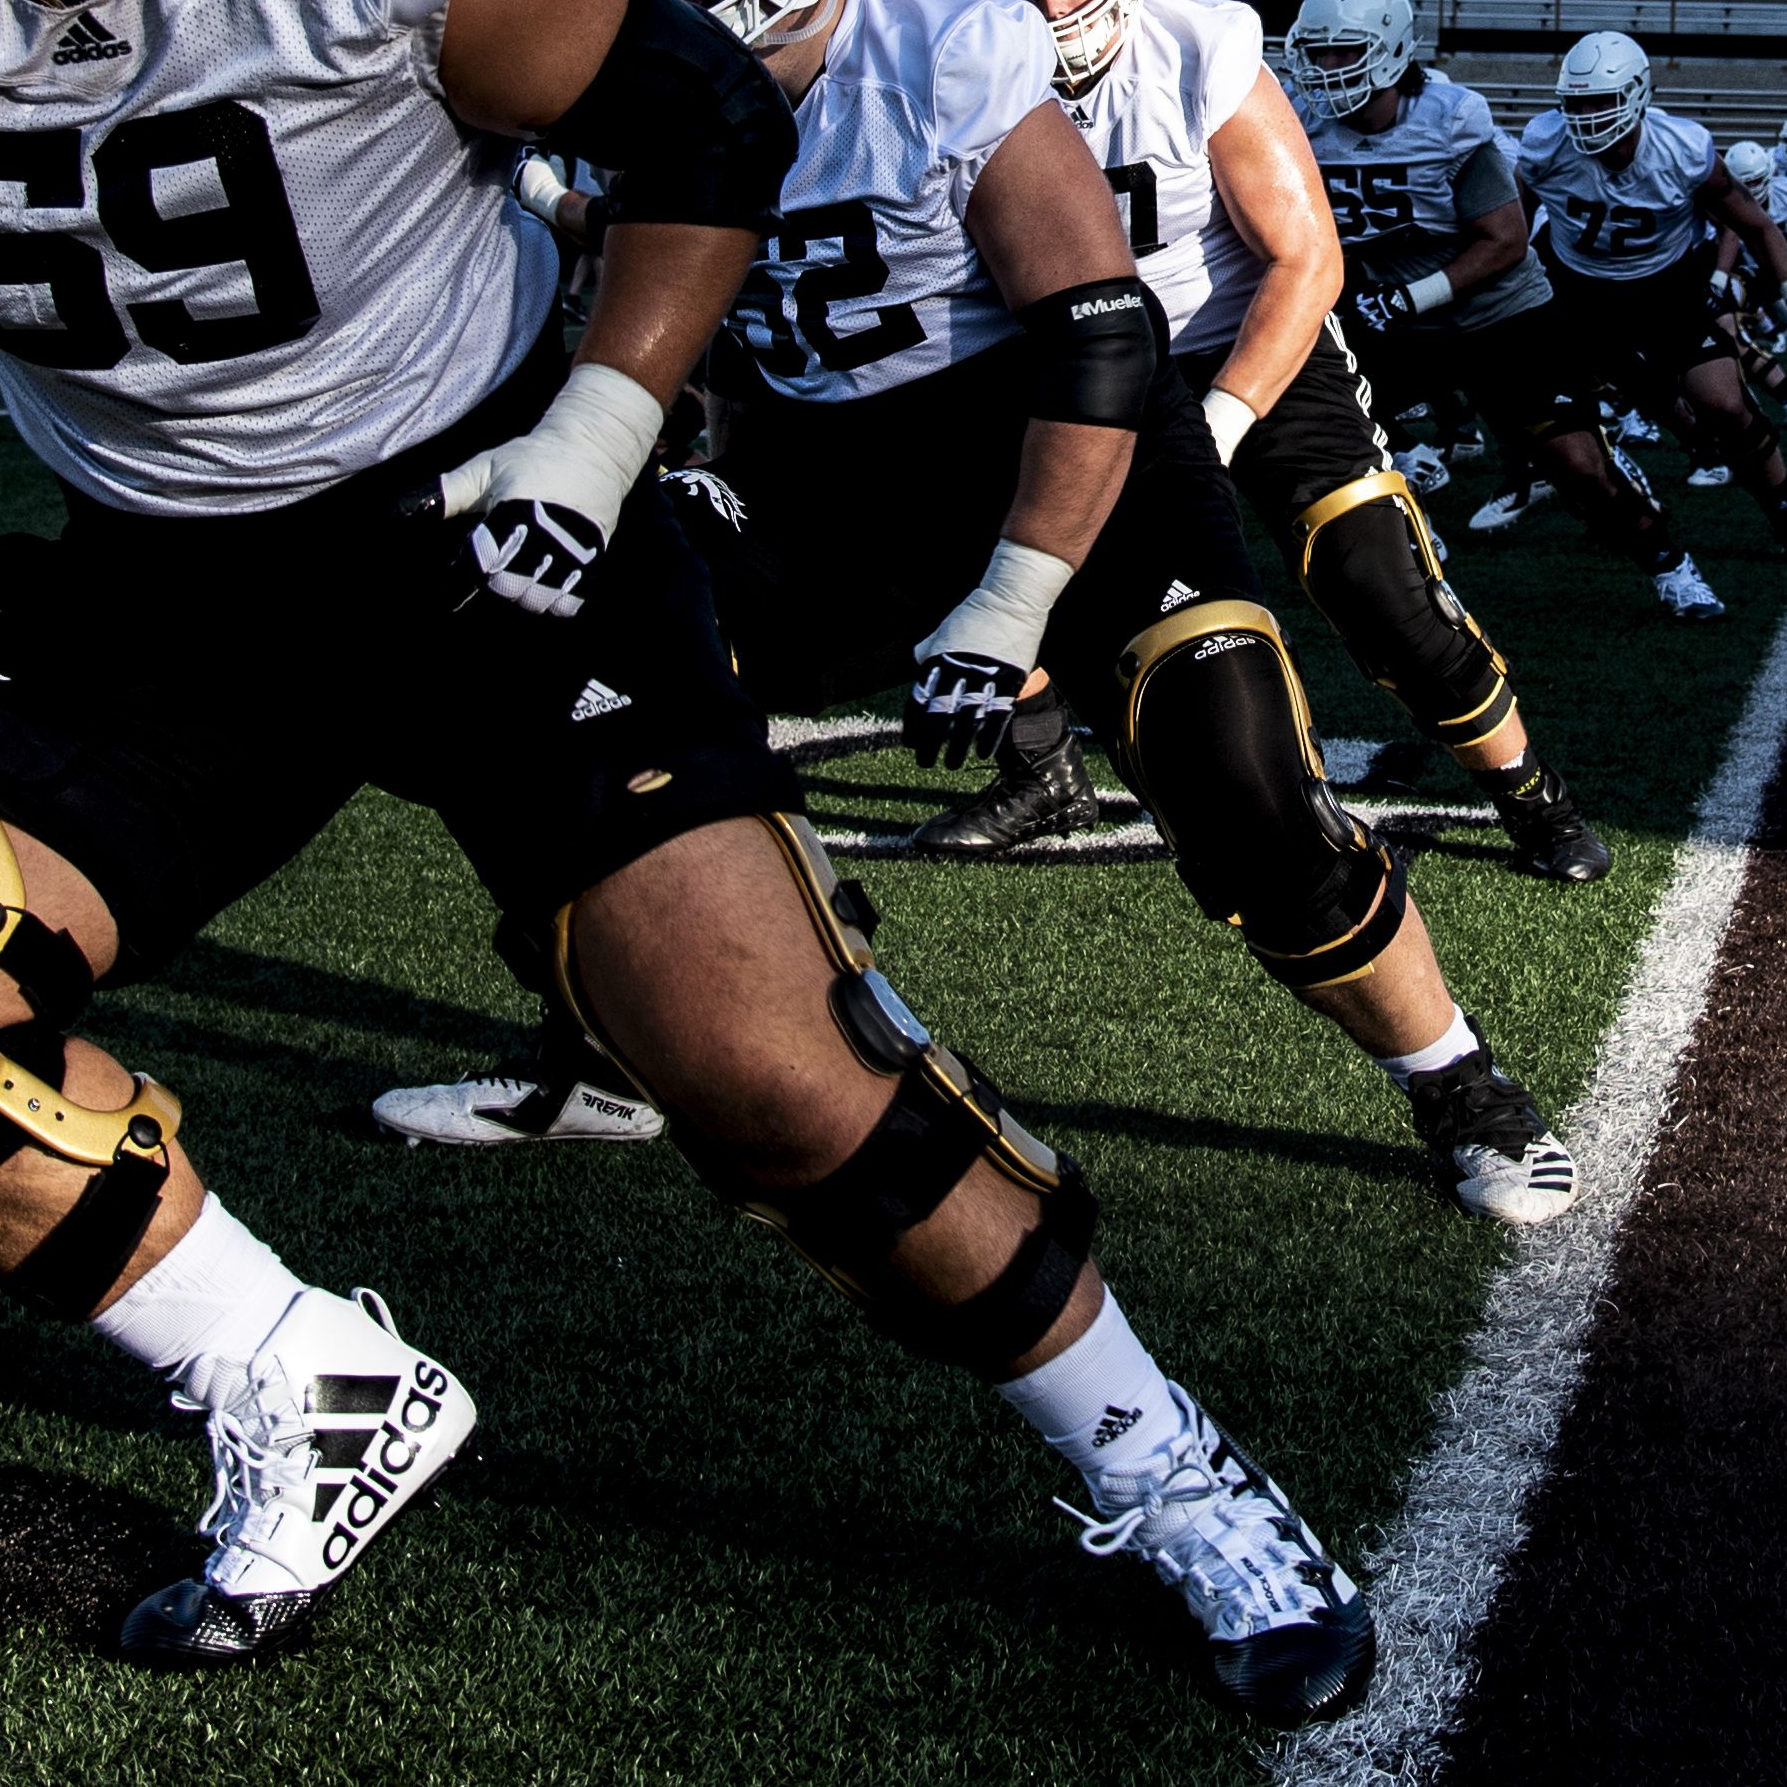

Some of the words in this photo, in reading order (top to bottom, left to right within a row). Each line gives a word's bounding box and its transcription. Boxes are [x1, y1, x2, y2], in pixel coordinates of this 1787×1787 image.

[52, 38, 133, 66] adidas
[1566, 197, 1656, 255] 72
[1194, 637, 1256, 660] adidas
[571, 694, 633, 722] adidas
[582, 1091, 637, 1121] FREAK
[1092, 1407, 1143, 1447] adidas
[322, 1360, 448, 1570] adidas
